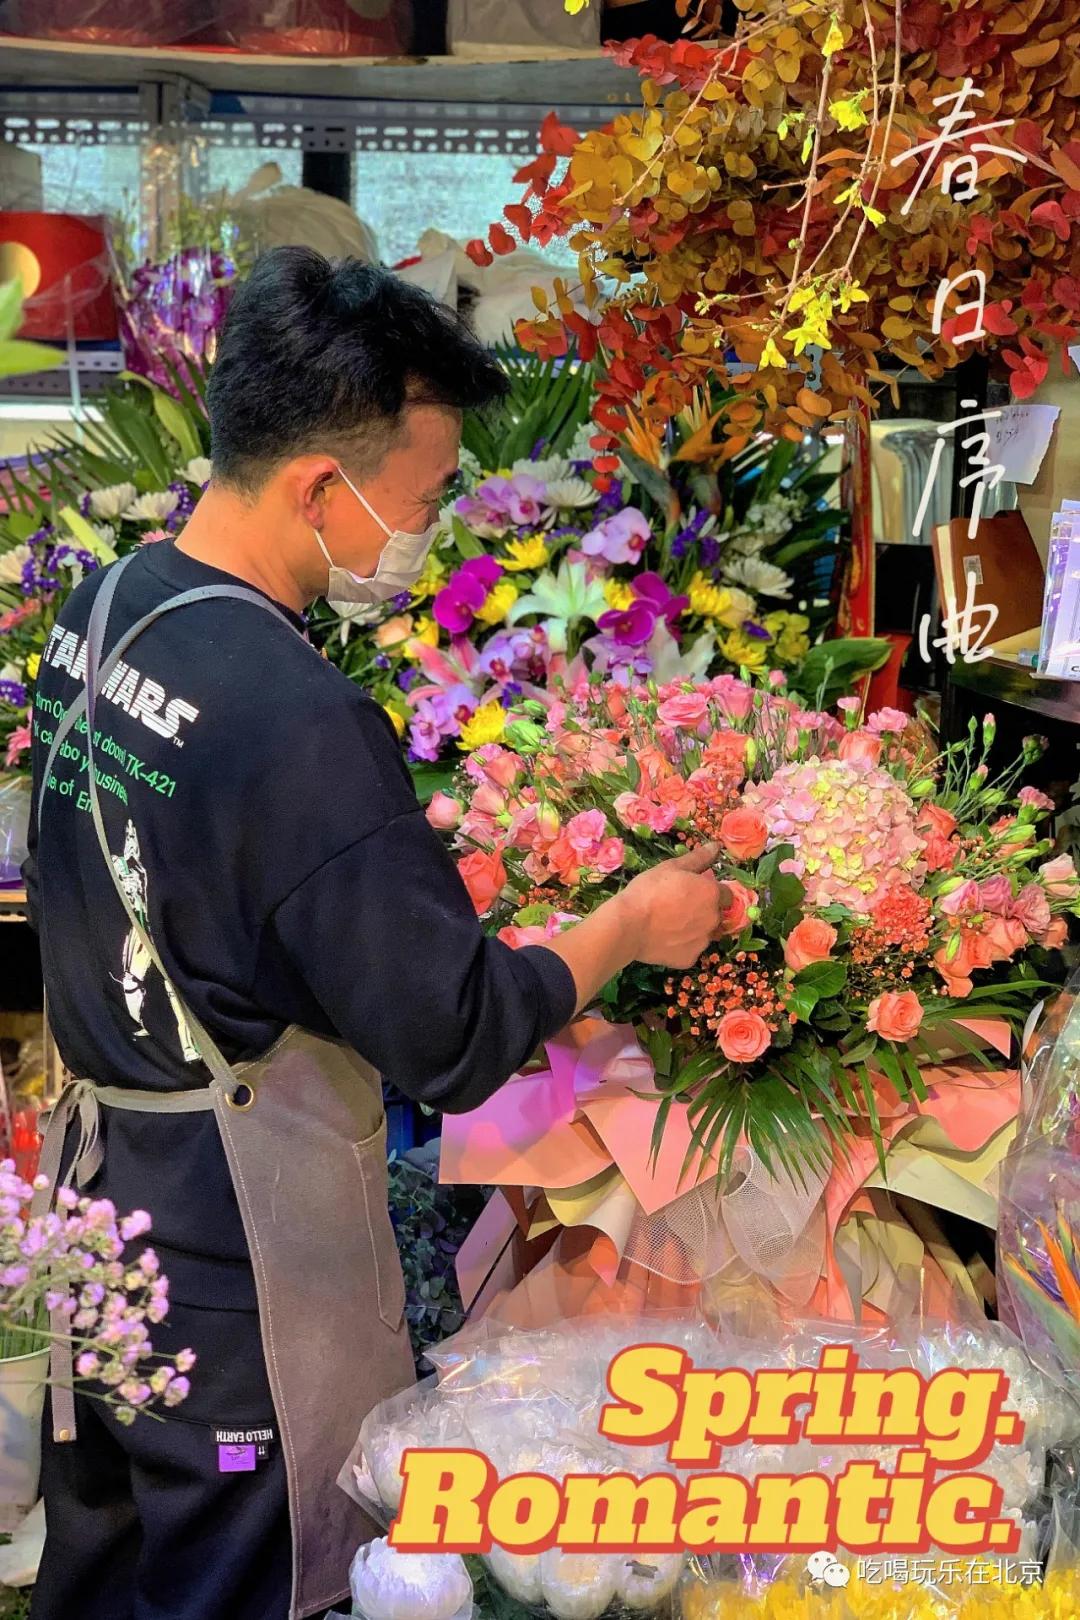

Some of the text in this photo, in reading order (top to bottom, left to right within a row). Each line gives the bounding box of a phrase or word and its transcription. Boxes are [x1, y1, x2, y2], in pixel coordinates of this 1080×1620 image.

[125, 754, 177, 798] TK-421
[59, 779, 75, 797] of
[216, 1428, 273, 1442] HELLO EARTH
